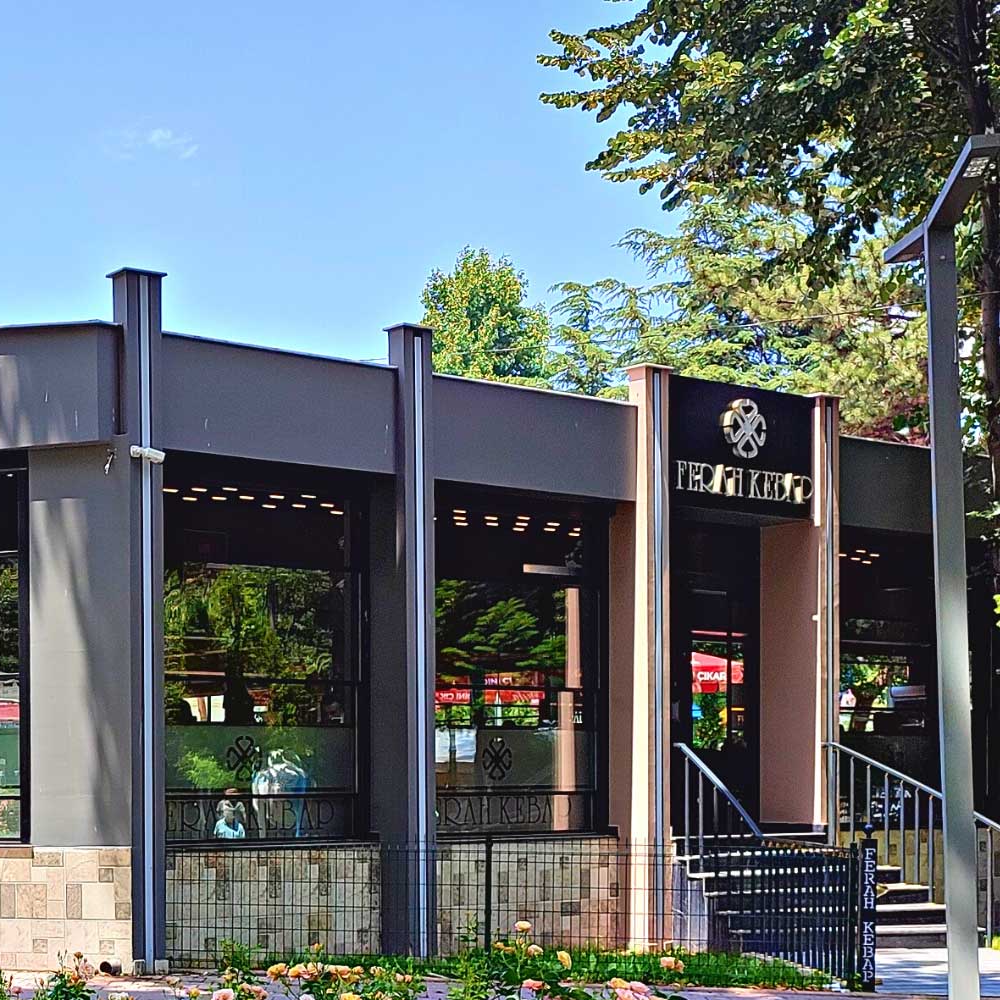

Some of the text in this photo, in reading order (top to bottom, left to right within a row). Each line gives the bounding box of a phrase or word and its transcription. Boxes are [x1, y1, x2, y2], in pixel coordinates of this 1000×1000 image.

[675, 460, 814, 504] FERAH KEBAP
[862, 848, 876, 983] FERAH KEBAP
